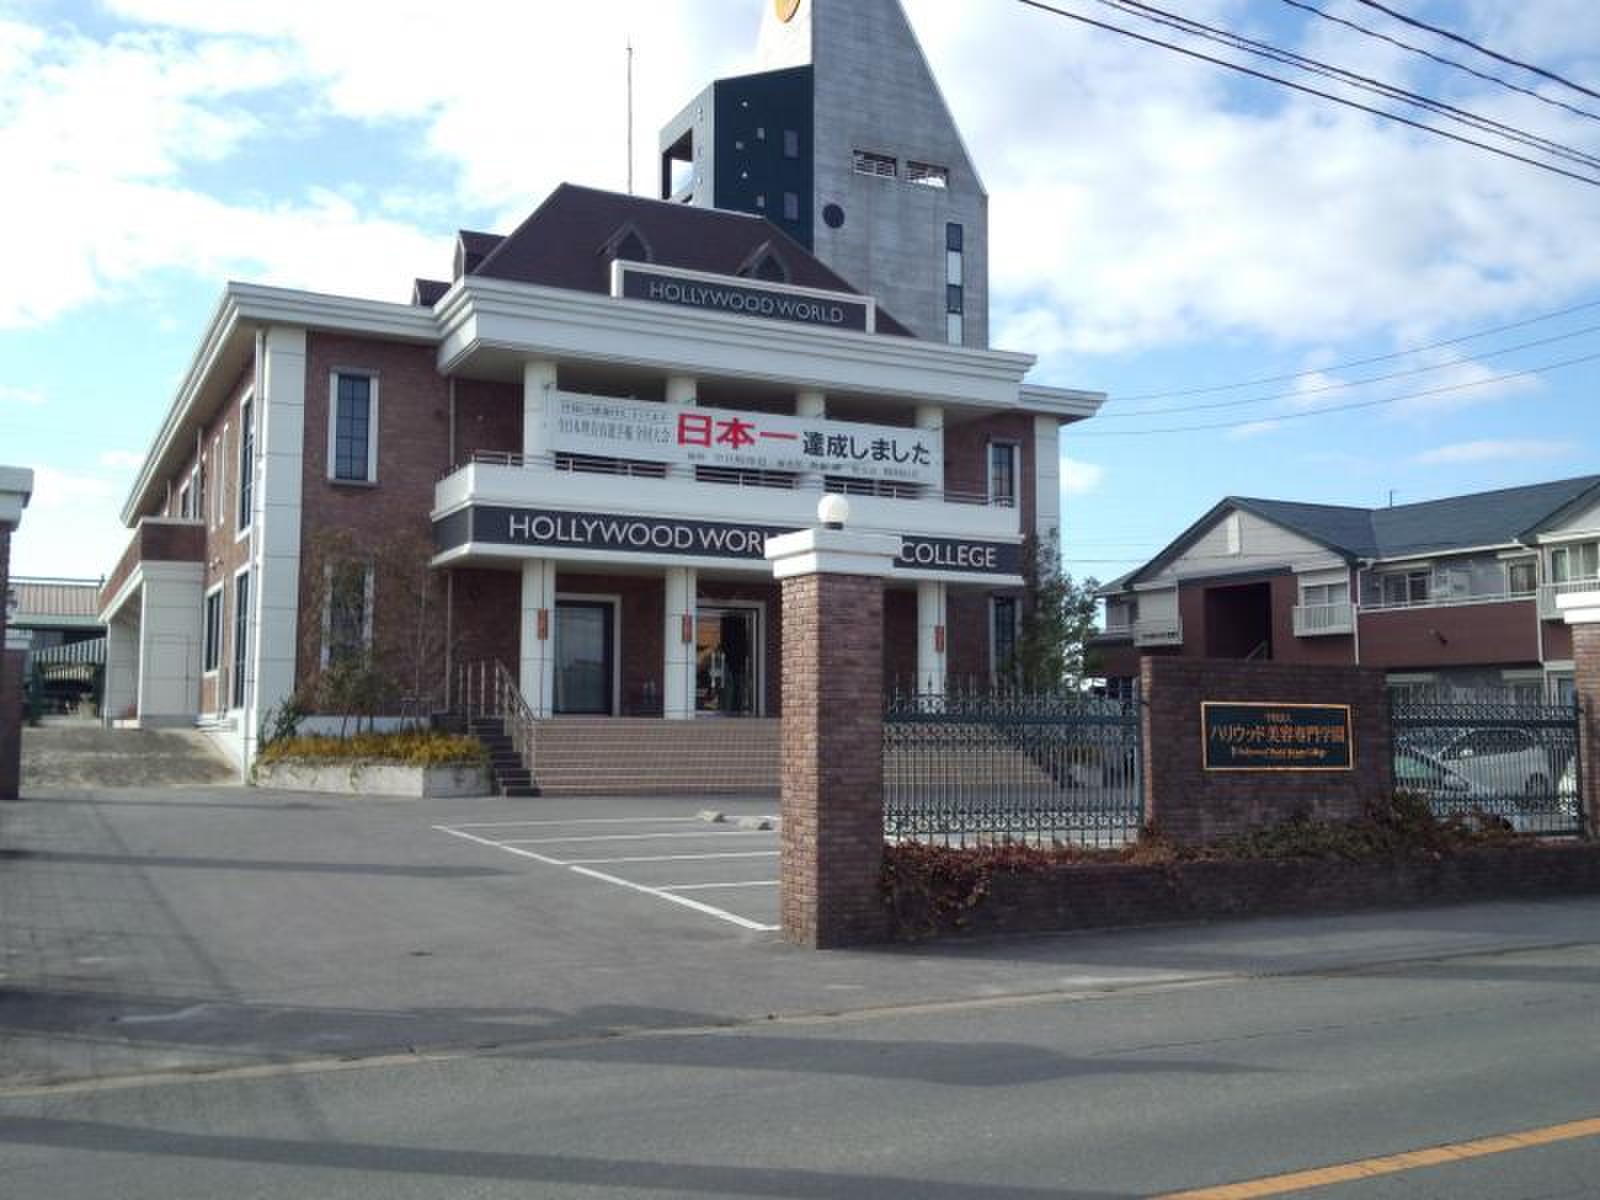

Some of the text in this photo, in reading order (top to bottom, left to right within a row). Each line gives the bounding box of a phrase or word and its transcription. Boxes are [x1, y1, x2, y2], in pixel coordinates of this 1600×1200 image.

[648, 281, 845, 323] HOLLYWOOD WORLD
[677, 412, 798, 449] 日本一
[802, 431, 931, 465] 達成しました
[508, 514, 997, 568] HOLLYWOOD WOR COLLEGE
